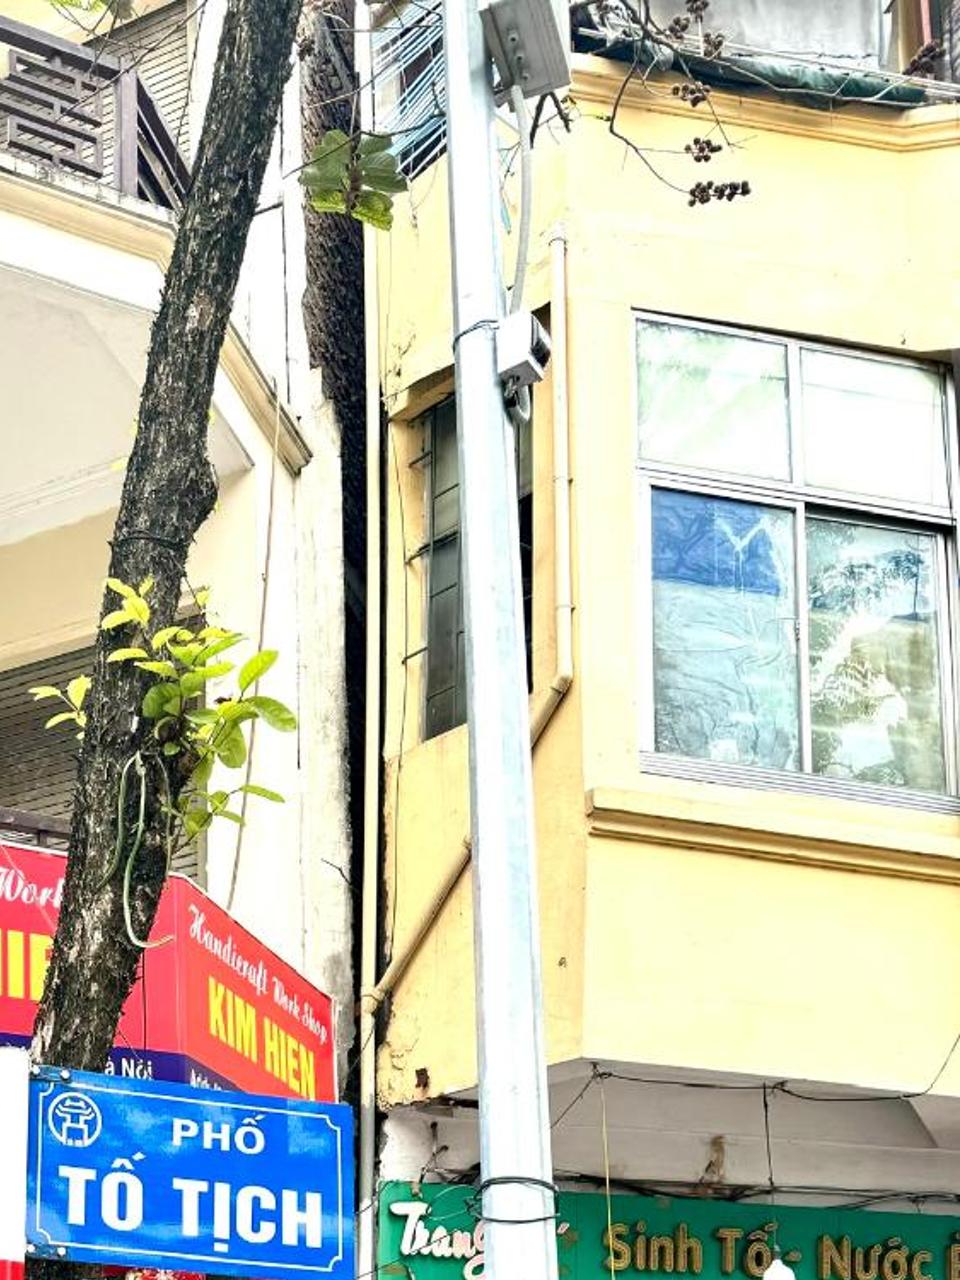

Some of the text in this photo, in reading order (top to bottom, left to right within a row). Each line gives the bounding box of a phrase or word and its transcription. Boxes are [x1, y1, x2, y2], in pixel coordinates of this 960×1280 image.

[188, 903, 328, 1045] Handicraft Work Shop
[208, 975, 316, 1102] KIM HIEN
[172, 1113, 265, 1155] PHỐ
[58, 1151, 146, 1232] TỐ
[173, 1177, 322, 1253] TỊCH
[604, 1223, 702, 1274] Sinh
